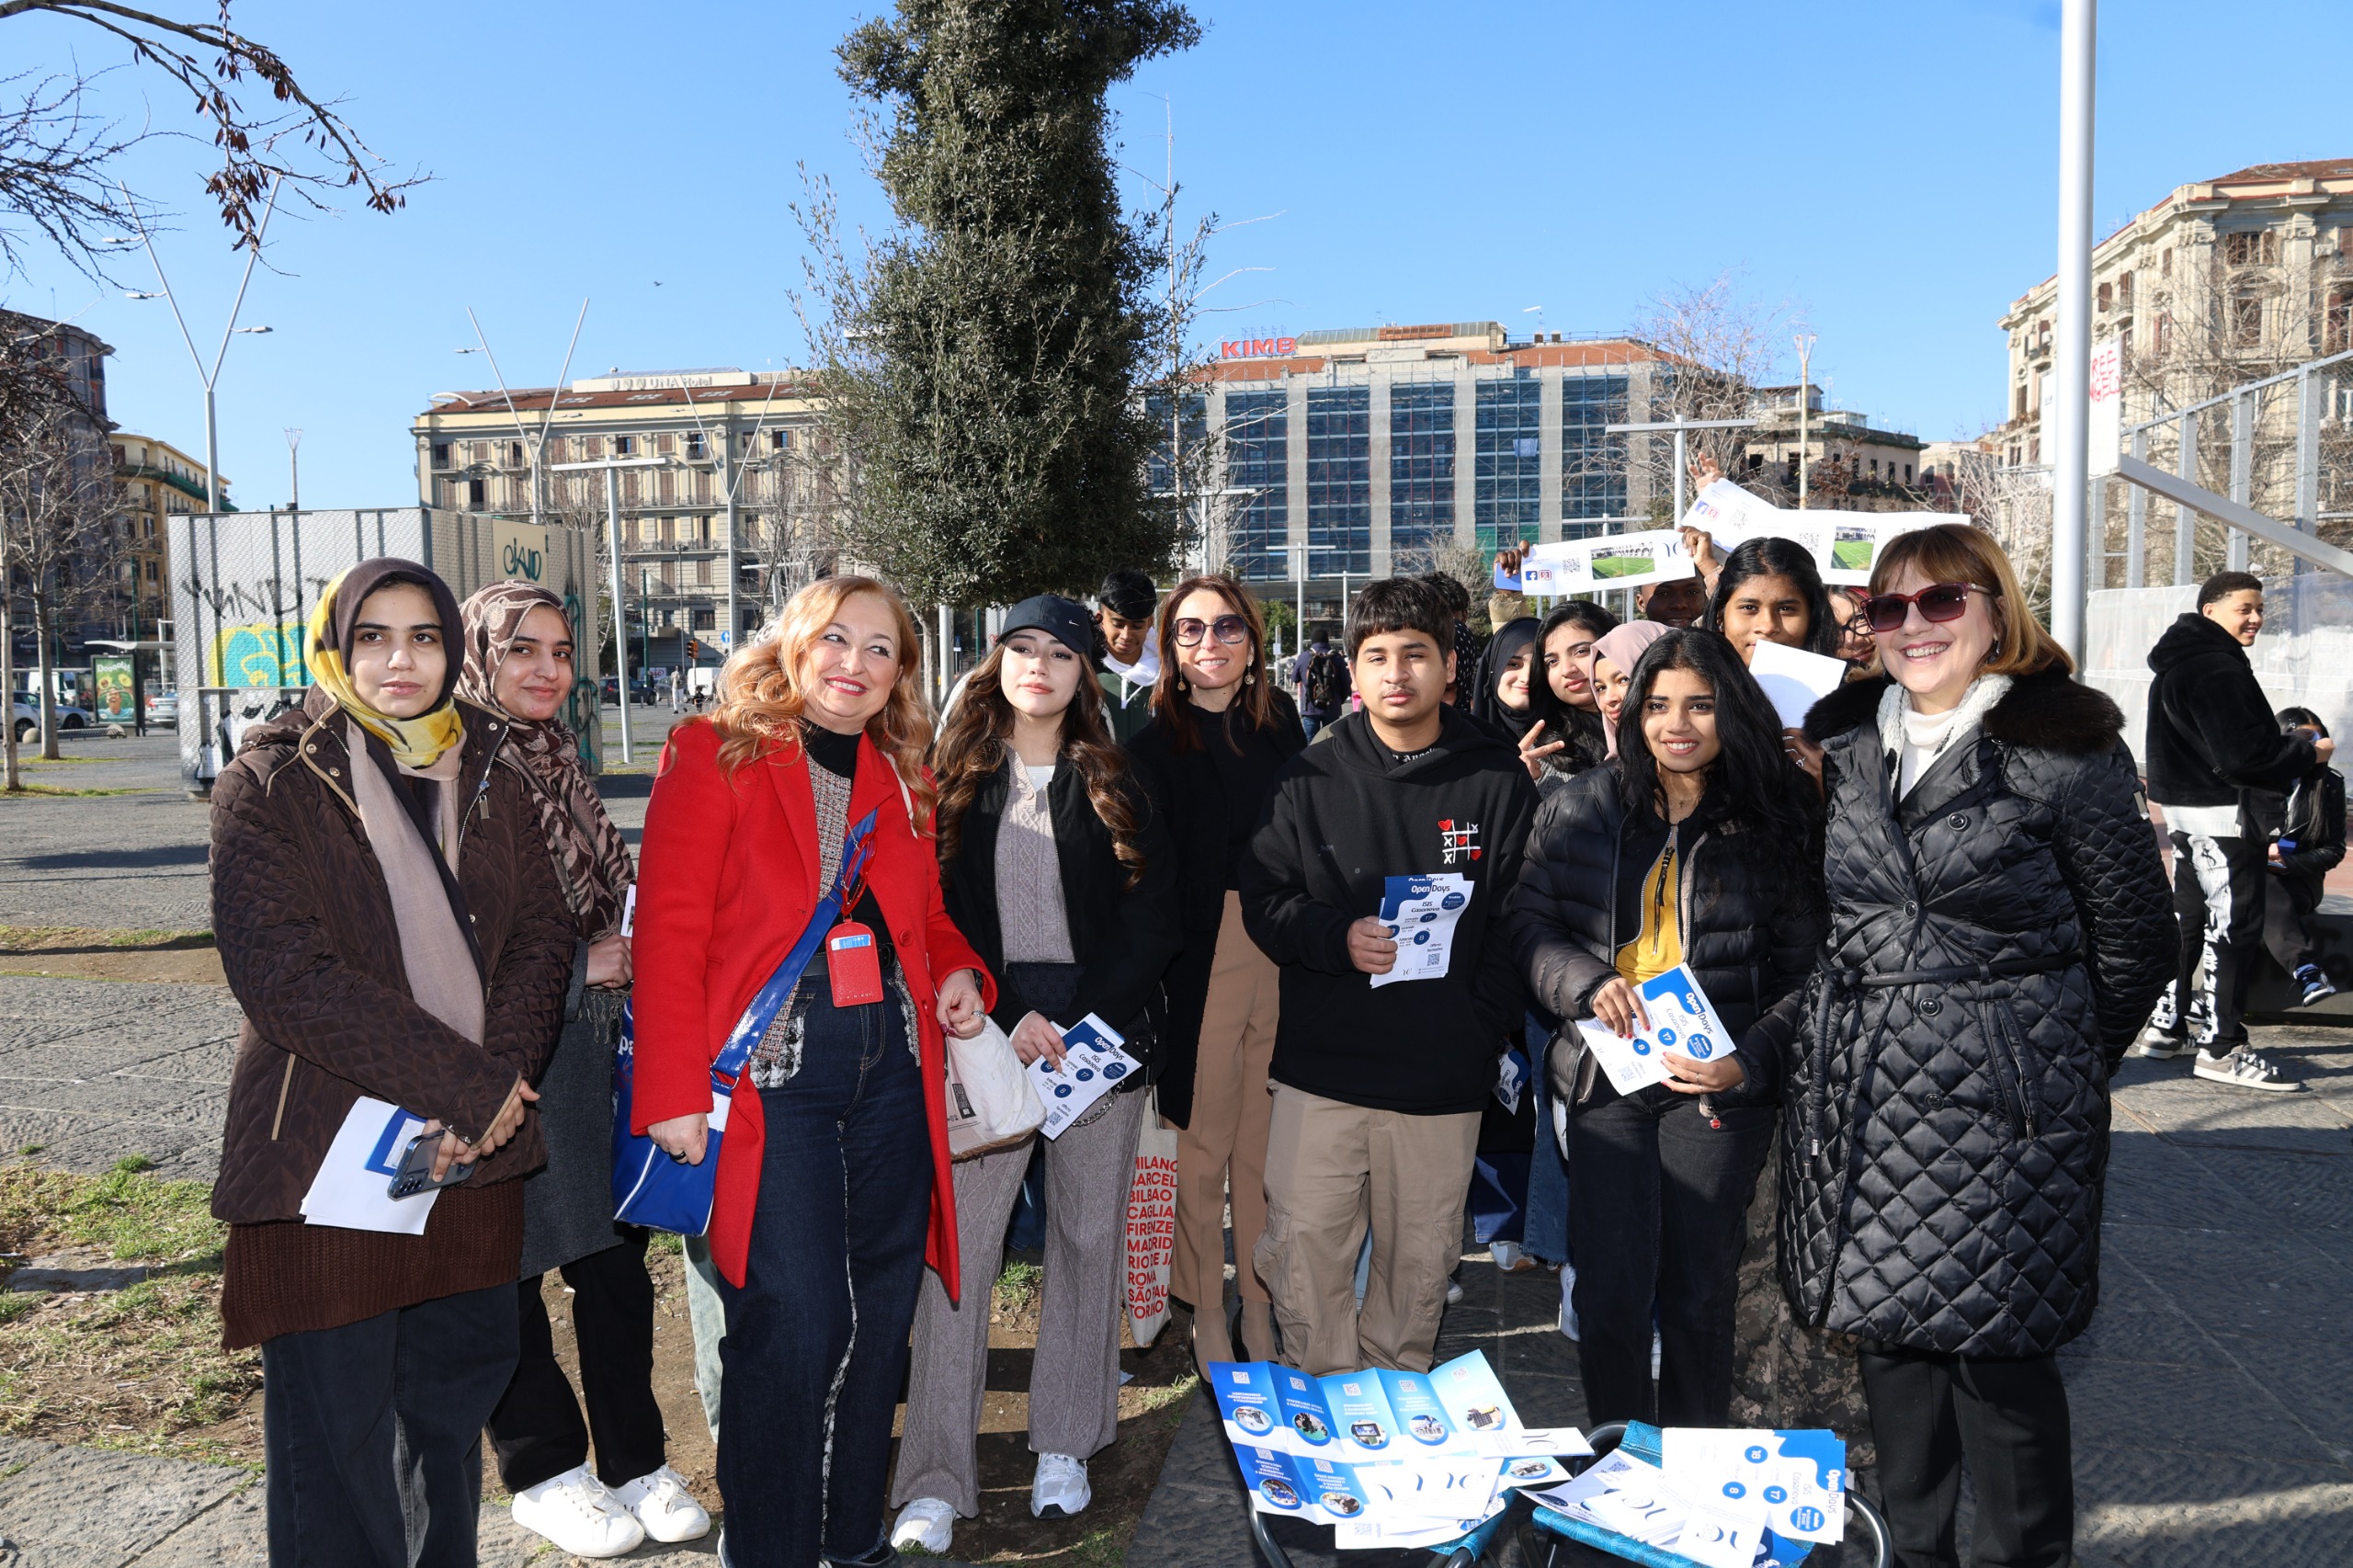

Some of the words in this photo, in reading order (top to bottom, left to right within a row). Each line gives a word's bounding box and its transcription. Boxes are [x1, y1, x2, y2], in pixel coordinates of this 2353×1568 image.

[1222, 337, 1296, 358] KIMB
[2090, 350, 2117, 378] REE
[1411, 884, 1430, 894] Open
[1431, 883, 1450, 893] Days
[1685, 992, 1702, 1015] Open
[1698, 1015, 1714, 1035] Days
[1665, 1008, 1687, 1040] Casanova
[1662, 1031, 1673, 1041] 17
[1095, 1036, 1110, 1052] Open
[1108, 1047, 1125, 1061] Days
[1078, 1053, 1102, 1073] Casanova
[1091, 1054, 1102, 1063] ISIS
[1129, 1188, 1173, 1203] BILBAO
[1127, 1204, 1175, 1220] CAGLIA
[1126, 1221, 1174, 1235] FIRENZE
[1127, 1236, 1173, 1253] MADRID
[1128, 1255, 1150, 1269] RIO
[1150, 1252, 1160, 1267] DE
[1128, 1269, 1157, 1286] ROMA
[1128, 1285, 1152, 1302] SÃO
[1152, 1284, 1170, 1300] PAU
[1128, 1299, 1164, 1320] TORINO
[1751, 1449, 1762, 1460] 18
[1825, 1469, 1842, 1492] Open
[1770, 1490, 1780, 1500] 17
[1826, 1492, 1839, 1515] Days
